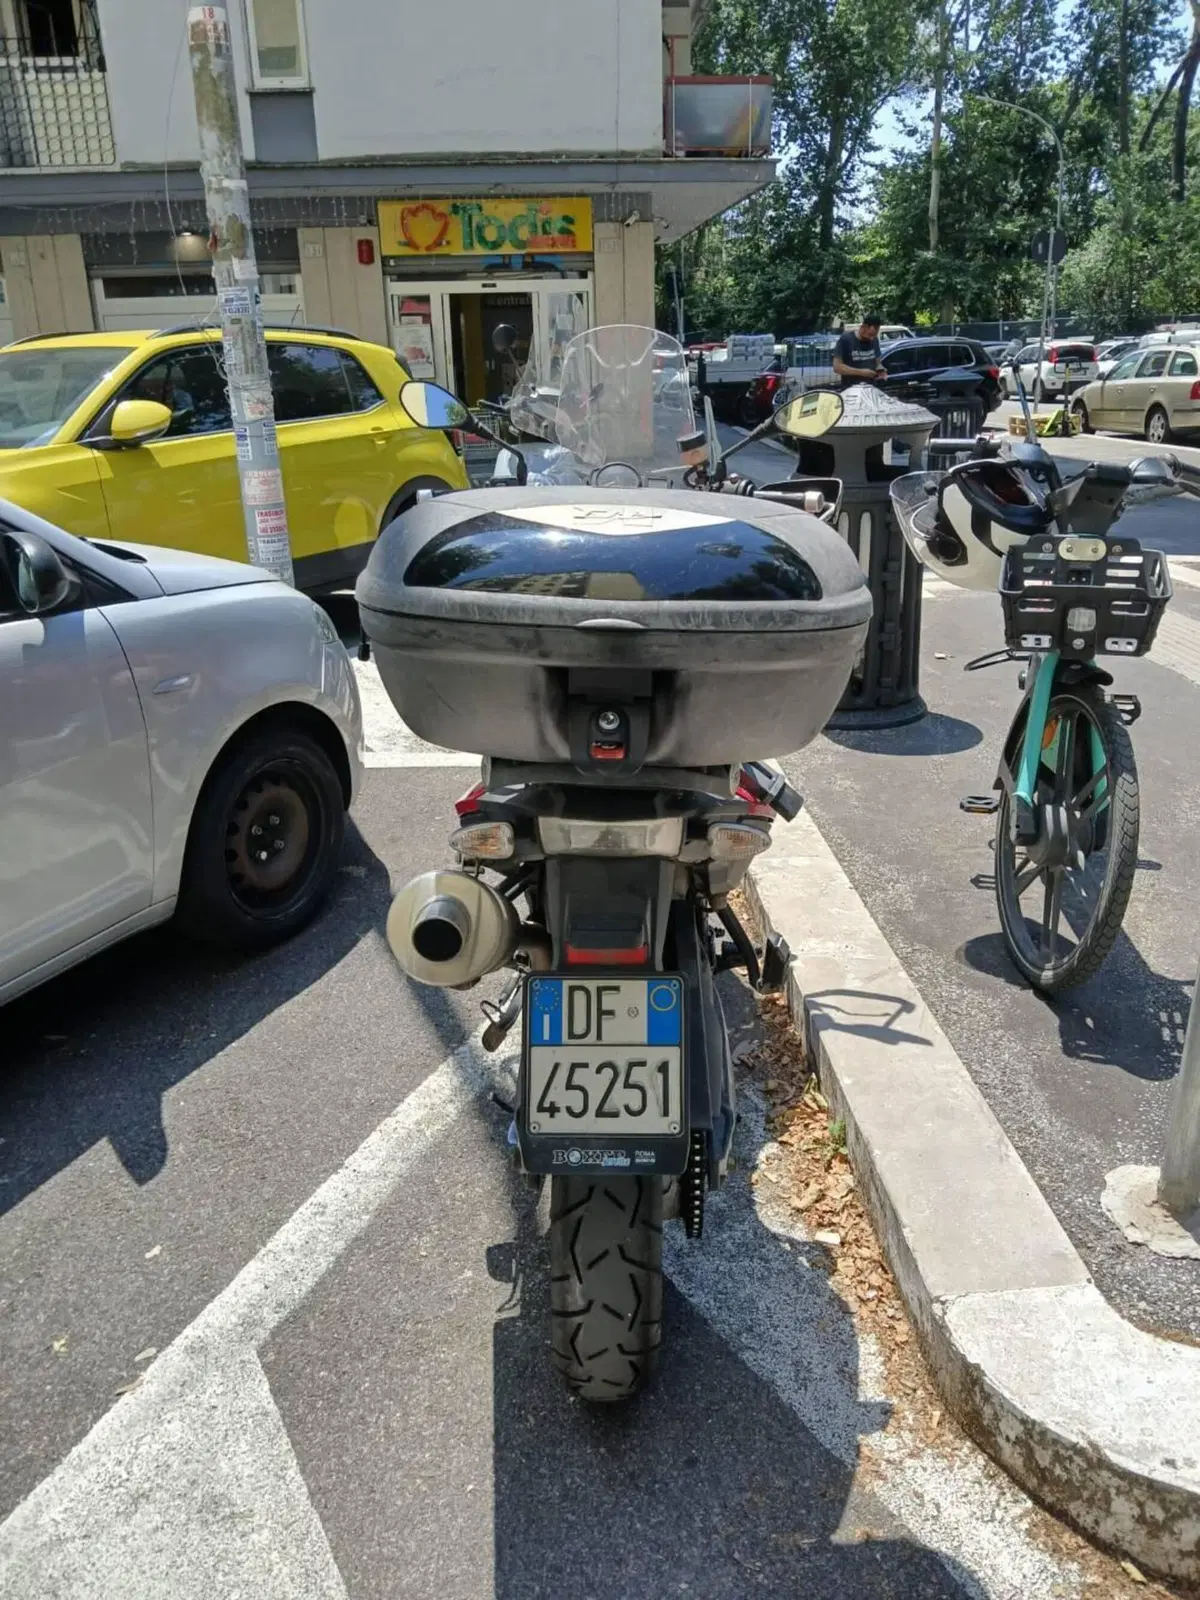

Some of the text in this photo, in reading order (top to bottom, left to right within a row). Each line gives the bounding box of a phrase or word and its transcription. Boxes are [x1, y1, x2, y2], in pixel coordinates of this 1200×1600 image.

[451, 201, 576, 250] Todis
[567, 985, 621, 1041] DF
[536, 1060, 670, 1118] 45251
